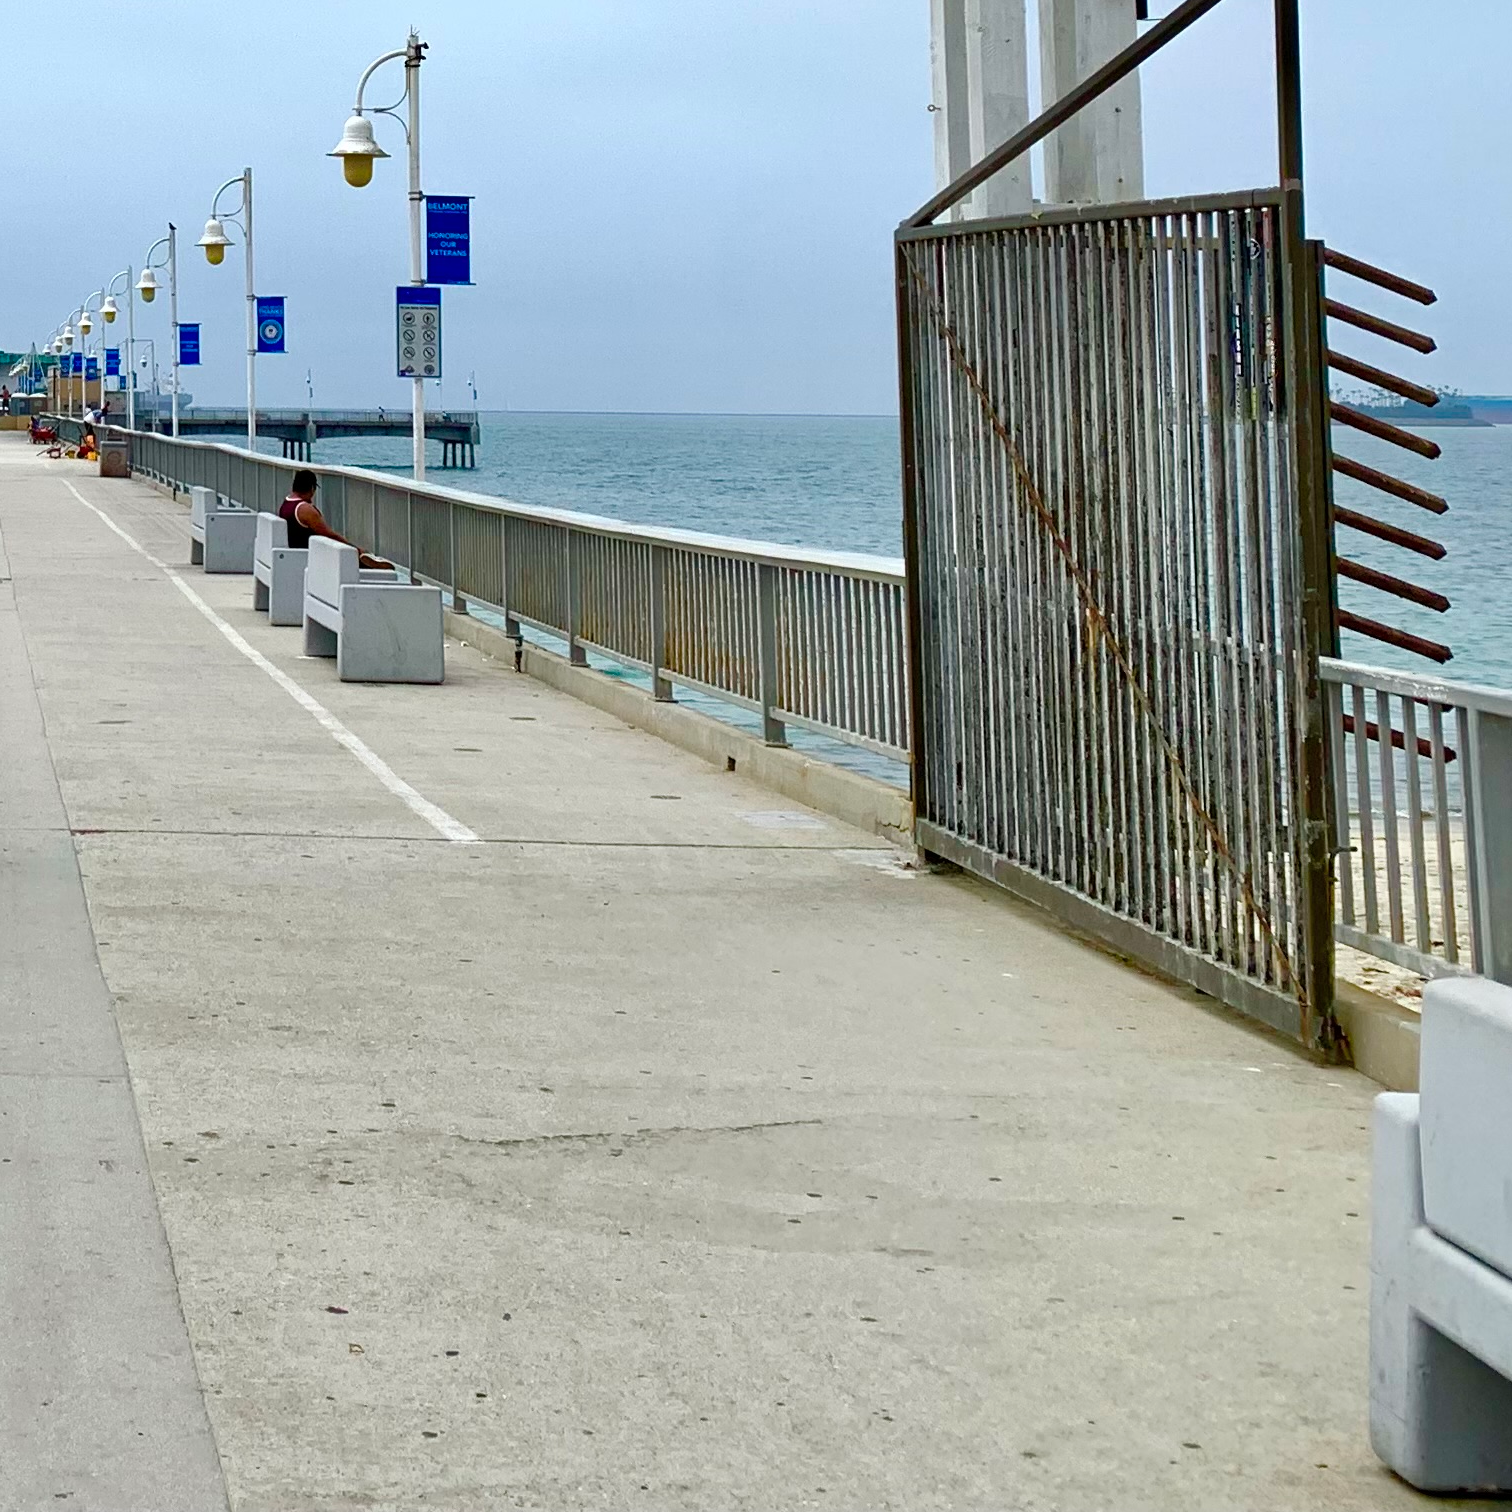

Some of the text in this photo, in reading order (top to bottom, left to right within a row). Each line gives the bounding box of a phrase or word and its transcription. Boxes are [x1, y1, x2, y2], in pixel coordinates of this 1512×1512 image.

[428, 202, 468, 211] BELMONT
[428, 232, 468, 240] HONORING
[429, 248, 467, 257] VETERANS
